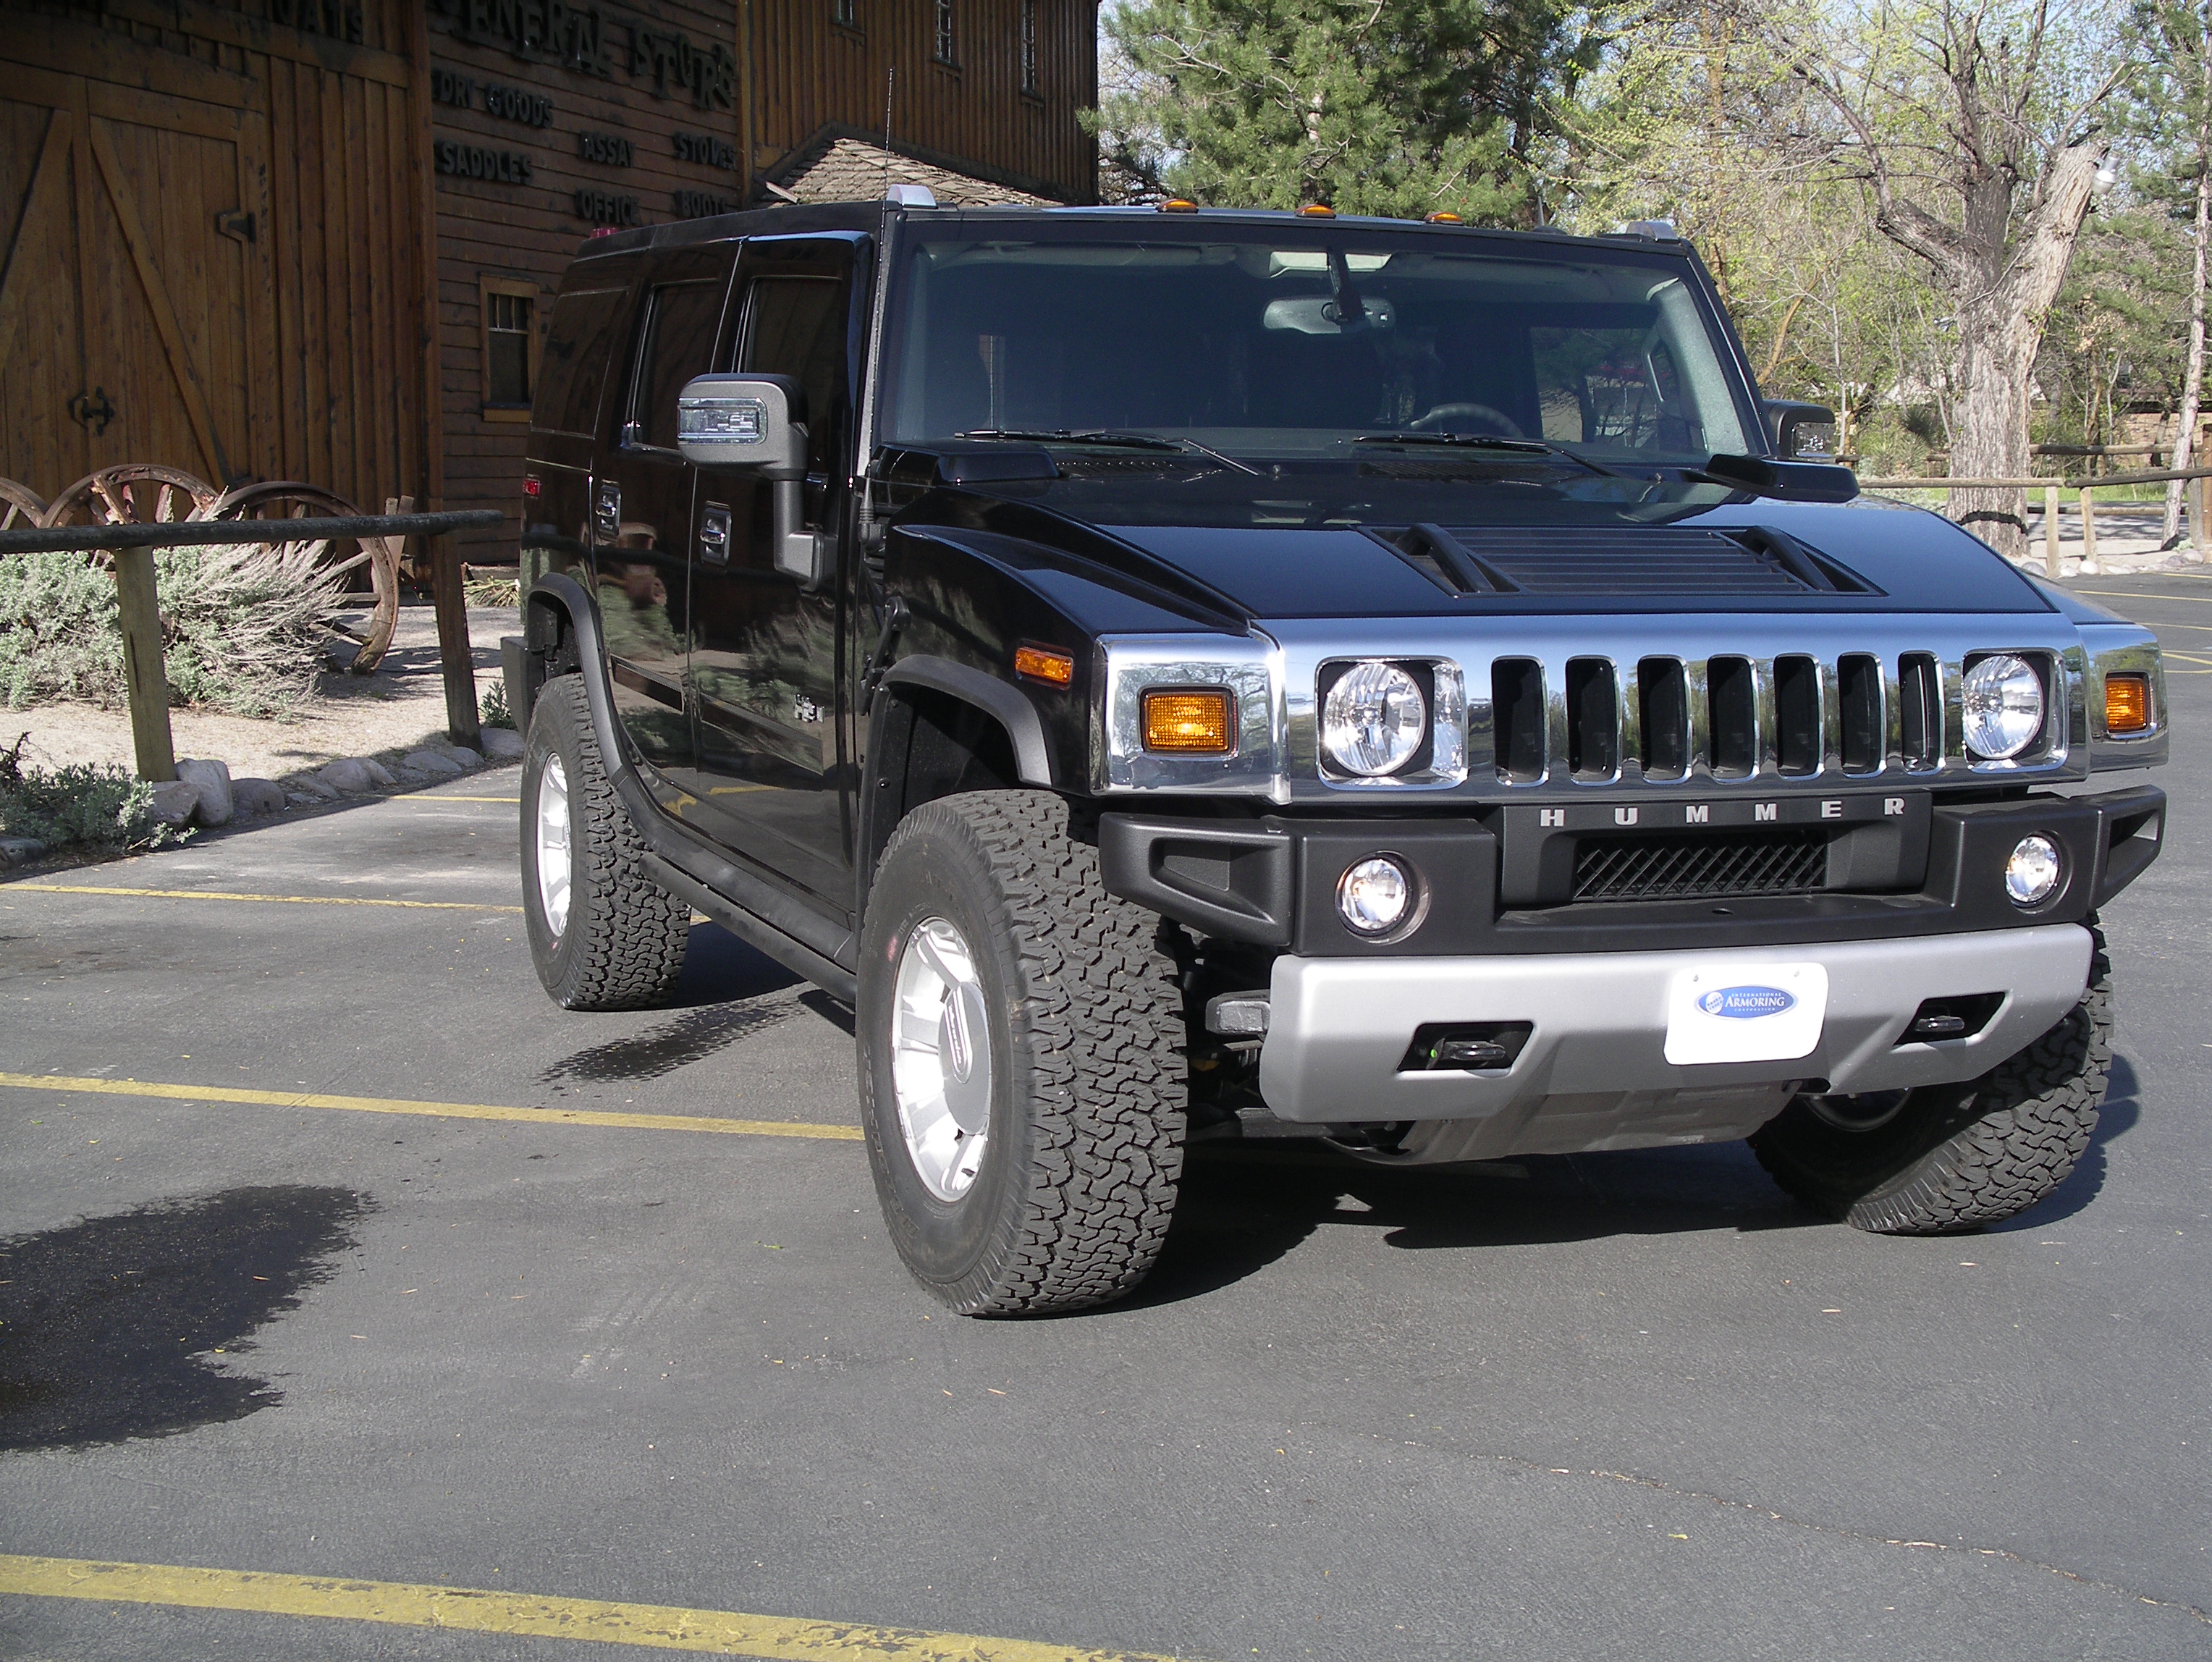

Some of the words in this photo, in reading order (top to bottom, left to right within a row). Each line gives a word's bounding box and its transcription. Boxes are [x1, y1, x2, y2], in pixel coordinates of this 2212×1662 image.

[433, 71, 475, 108] DRY
[484, 83, 554, 129] GOODS
[434, 139, 534, 185] SADDLES
[580, 131, 636, 168] ASSAY
[673, 132, 738, 172] STOVES
[576, 189, 641, 227] OFFICE
[1539, 797, 1905, 827] HUMMER
[1725, 995, 1785, 1008] ARMORING
